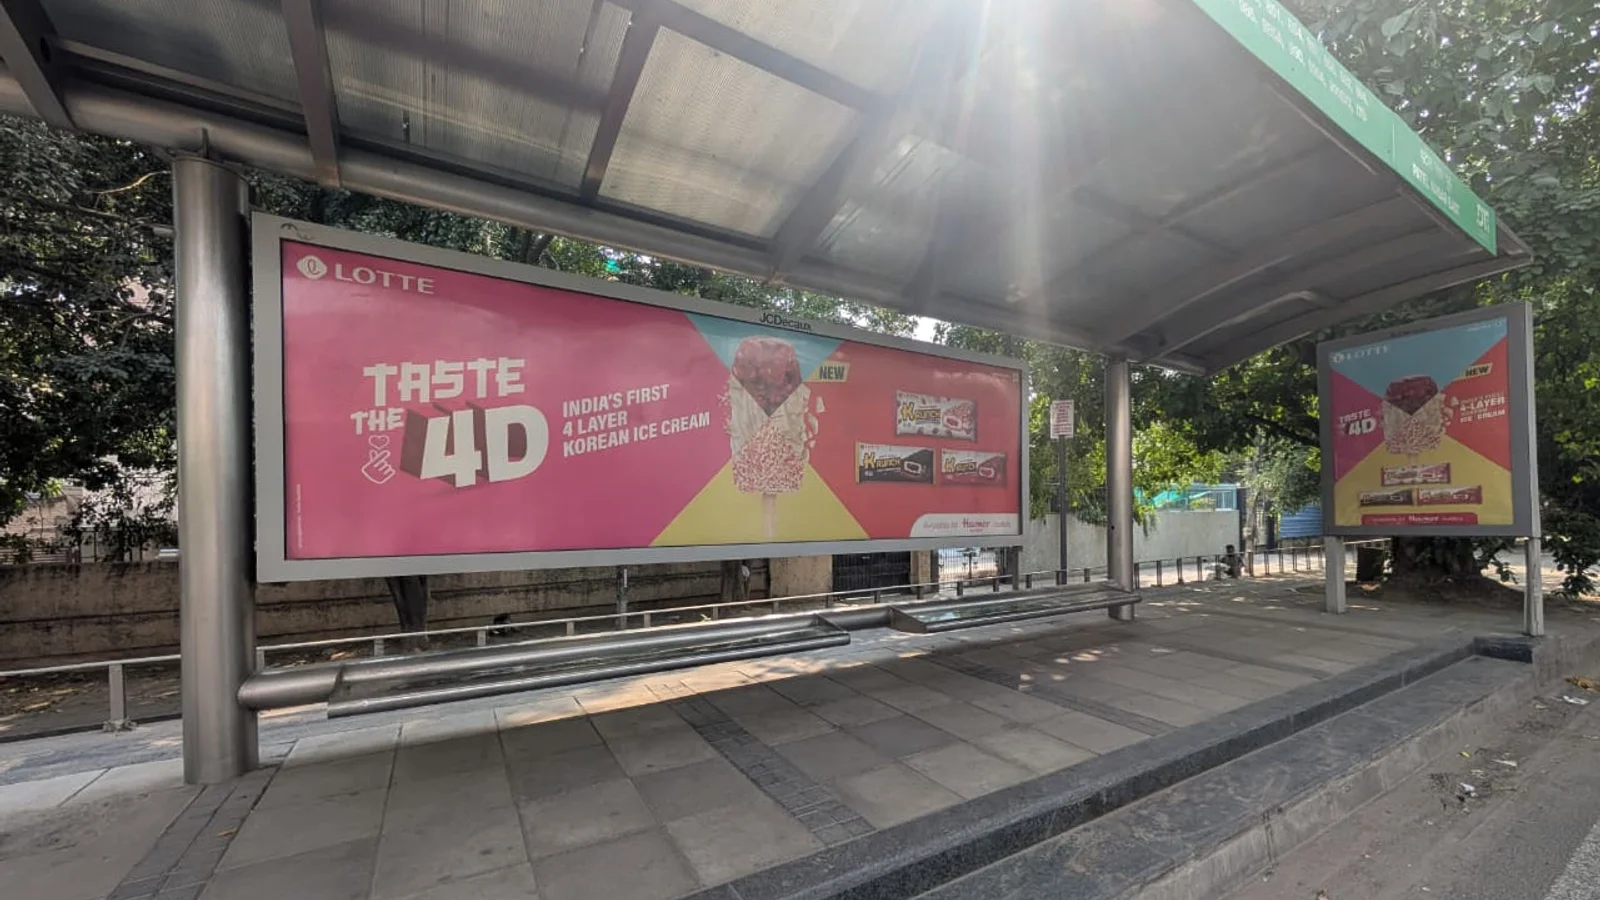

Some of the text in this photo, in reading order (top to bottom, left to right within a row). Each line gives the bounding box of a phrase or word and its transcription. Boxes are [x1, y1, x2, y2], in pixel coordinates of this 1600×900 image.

[335, 263, 435, 295] LOTTE
[760, 312, 812, 331] JCDecaux
[363, 357, 525, 406] TASTE
[820, 366, 845, 379] NEW
[562, 384, 670, 418] INDIA'S FIRST
[350, 408, 404, 435] THE
[562, 411, 628, 437] 4 LAYER
[563, 412, 710, 457] KOREAN ICE CREAM
[420, 405, 549, 488] 4D
